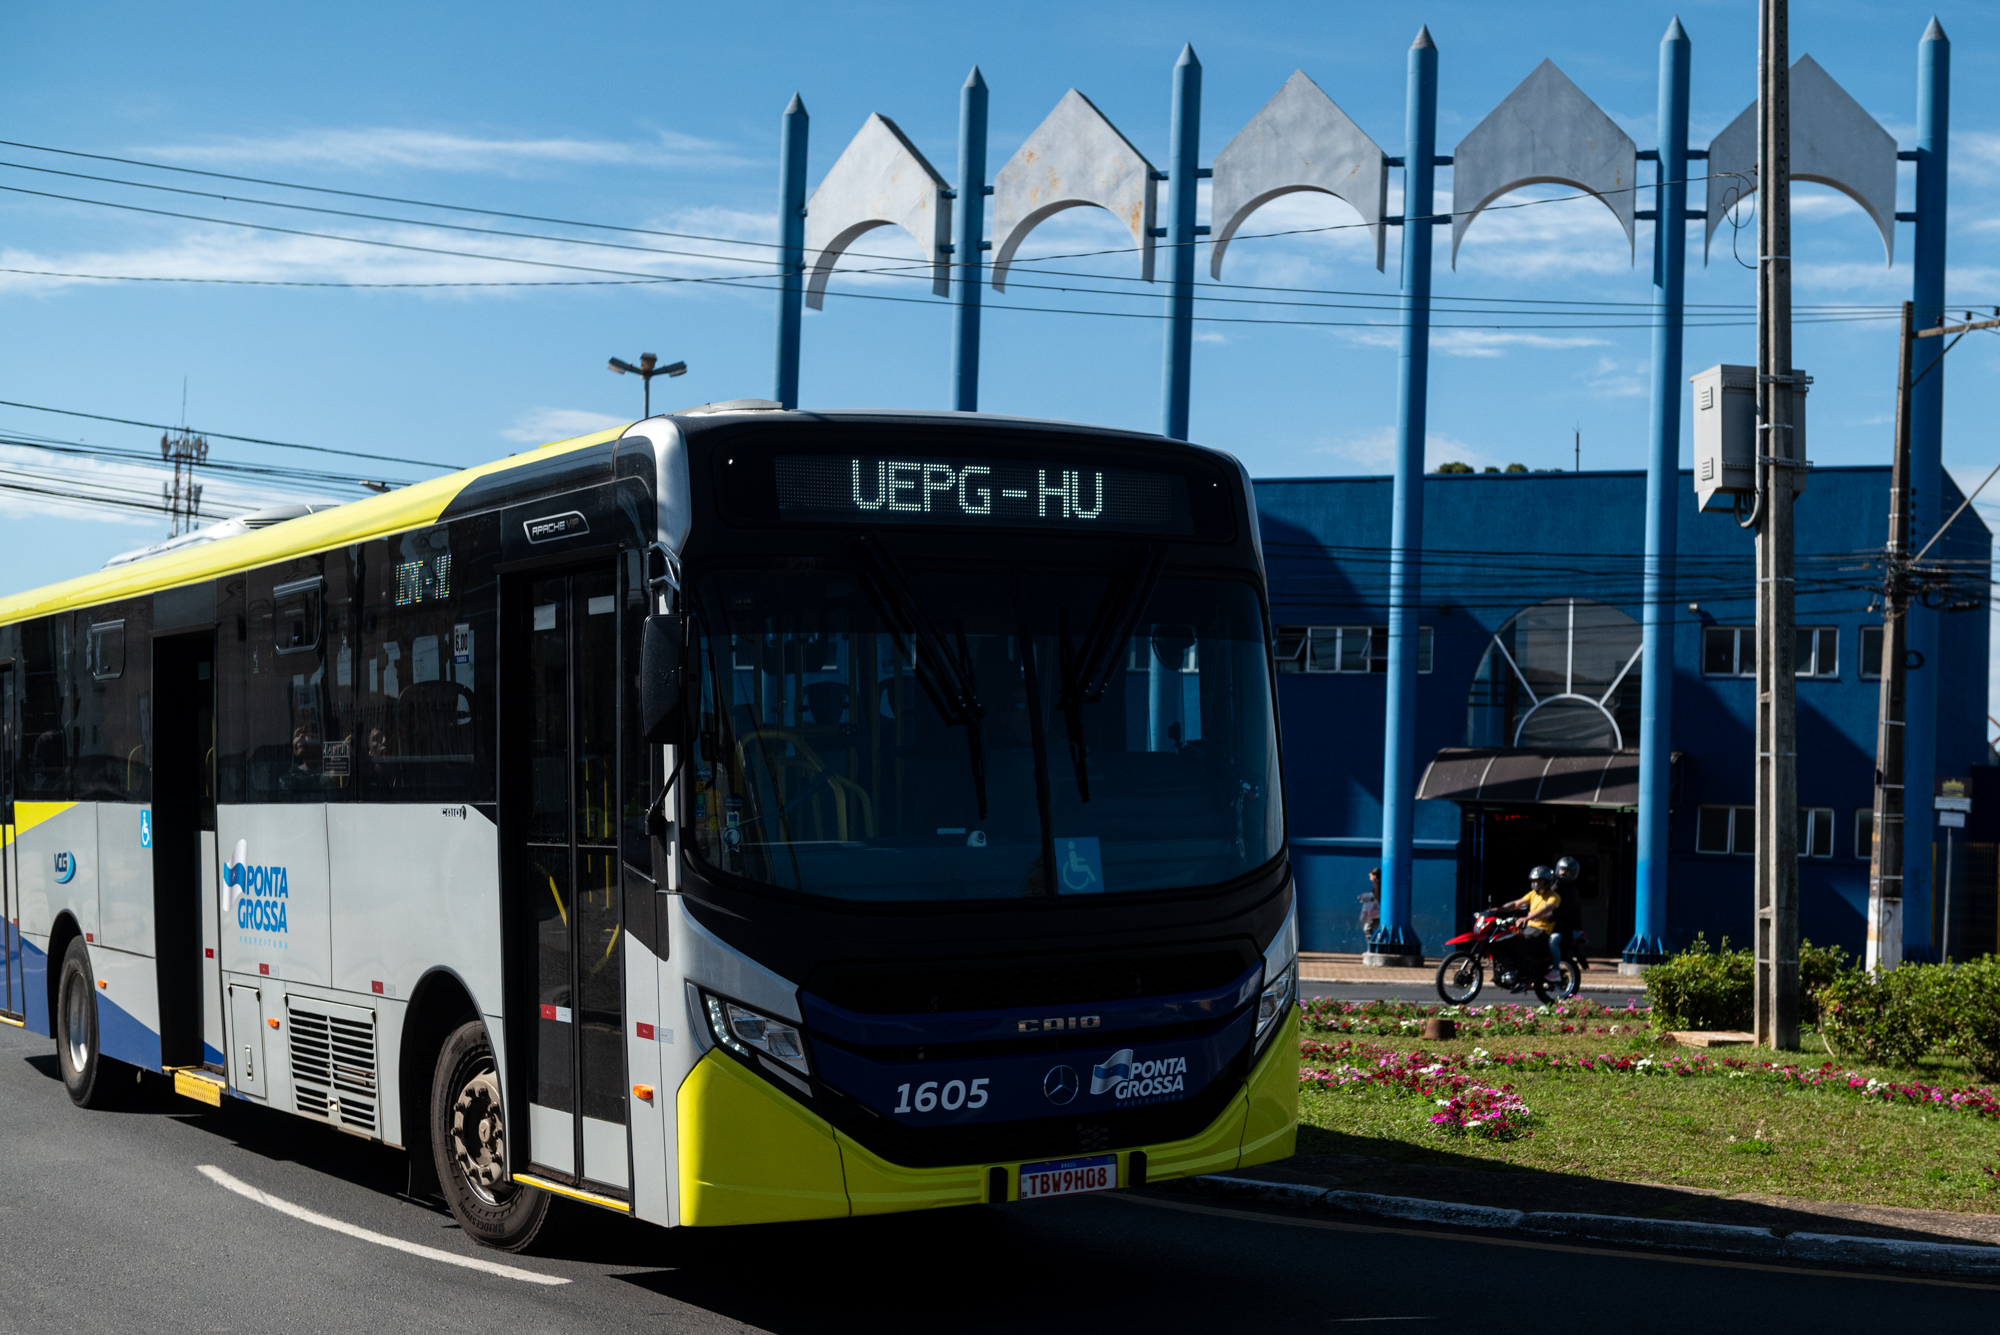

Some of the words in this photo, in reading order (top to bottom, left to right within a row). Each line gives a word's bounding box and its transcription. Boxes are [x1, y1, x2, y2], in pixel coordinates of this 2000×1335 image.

[532, 520, 565, 536] APACHE
[566, 517, 579, 529] VIP
[455, 633, 469, 654] 6,00
[441, 807, 462, 818] CAIO
[53, 852, 68, 873] VCG
[246, 864, 289, 899] PONTA
[237, 897, 288, 934] GROSSA
[239, 935, 288, 949] PREFEITURA
[1017, 1015, 1101, 1033] CAIO
[1129, 1056, 1187, 1080] PONTA
[893, 1077, 990, 1114] 1605
[1115, 1074, 1184, 1100] GROSSA
[1116, 1093, 1184, 1108] PREFEITURA
[1028, 1167, 1108, 1196] TBW9H08
[1021, 1191, 1028, 1199] BR
[457, 1199, 505, 1234] BRIDGESTONE
